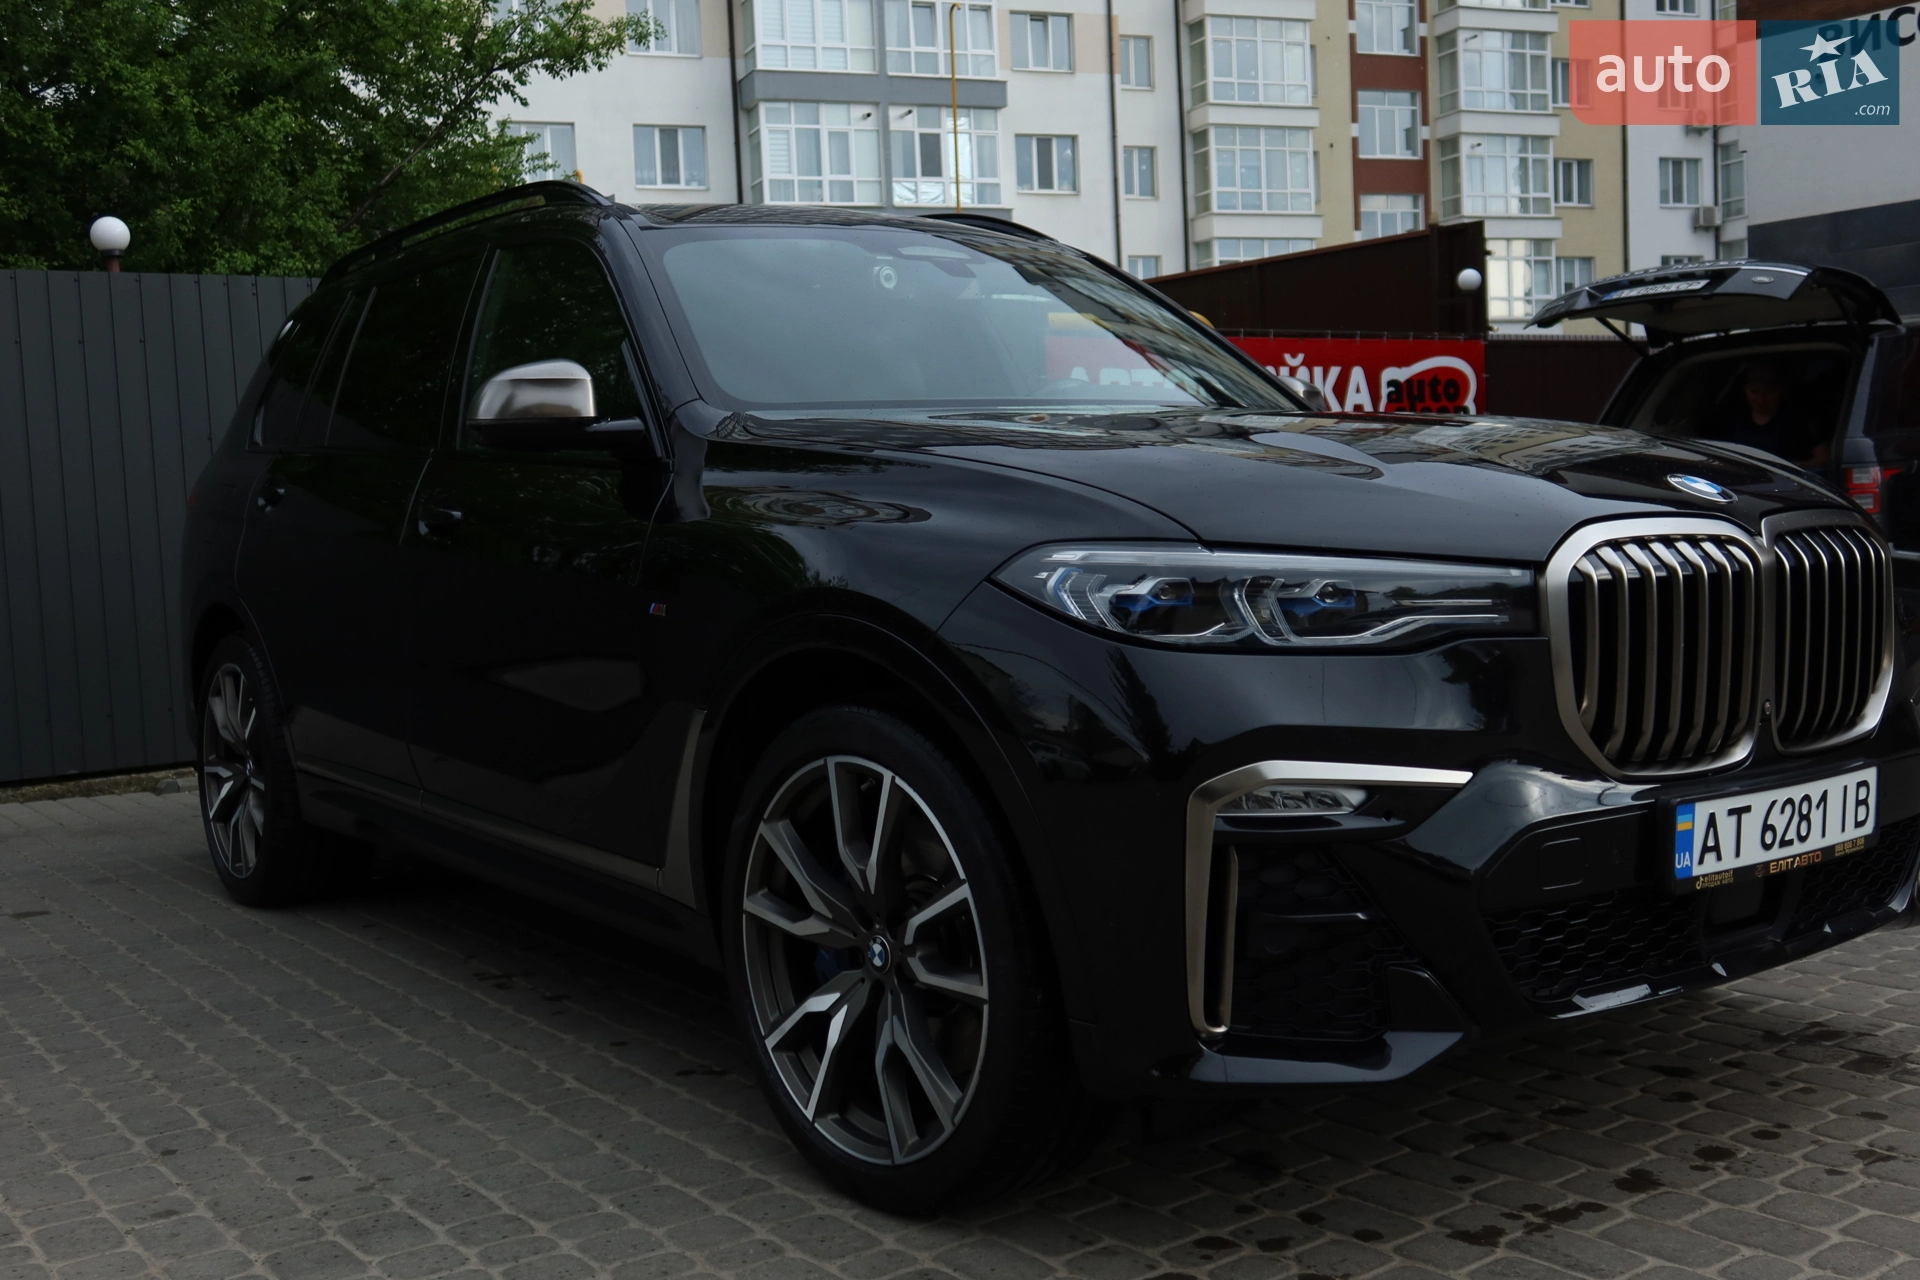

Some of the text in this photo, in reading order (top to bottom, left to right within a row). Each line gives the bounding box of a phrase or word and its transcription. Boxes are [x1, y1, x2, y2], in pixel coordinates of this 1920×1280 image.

[1818, 6, 1920, 63] ВИС
[1386, 374, 1460, 403] auto
[1698, 779, 1870, 866] AT 6281 IB
[1675, 852, 1691, 869] UA
